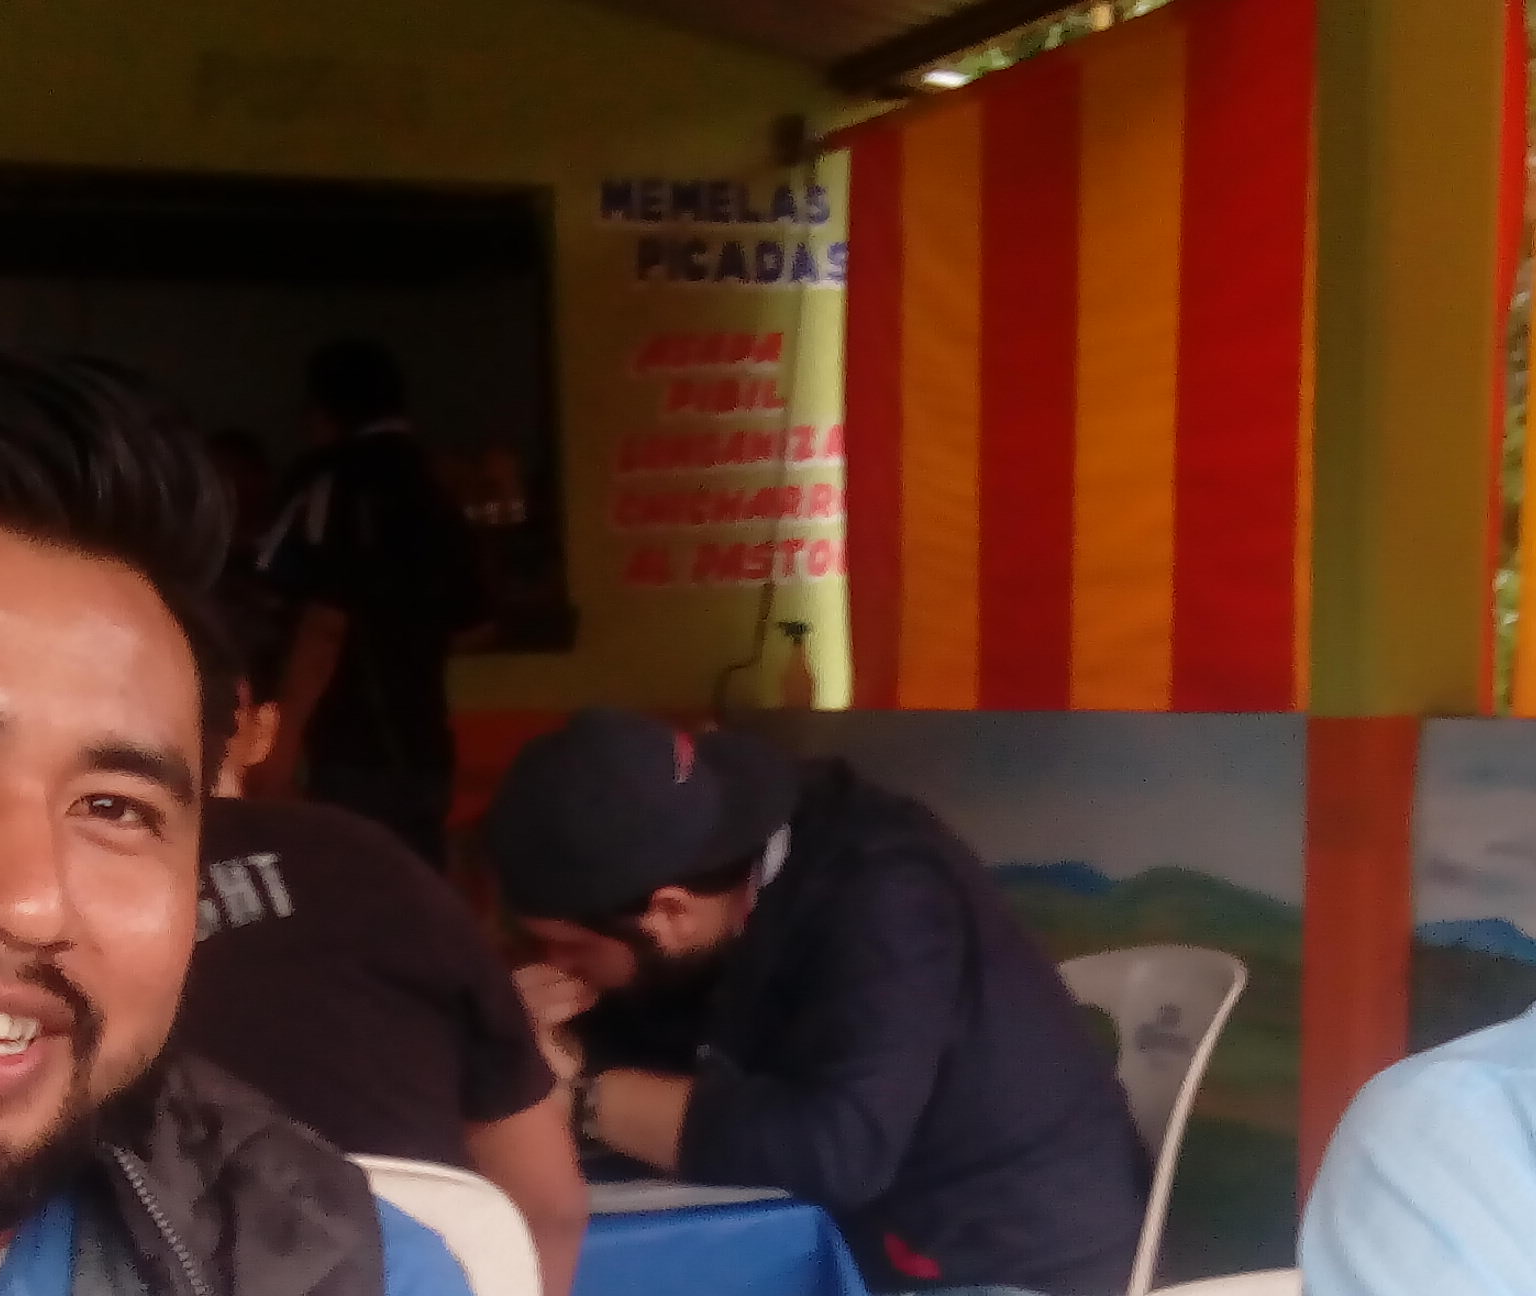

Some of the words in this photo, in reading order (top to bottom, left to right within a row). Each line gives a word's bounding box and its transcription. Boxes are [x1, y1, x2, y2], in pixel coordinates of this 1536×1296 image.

[600, 179, 831, 223] MEMELAS
[635, 238, 848, 282] PICADAS
[612, 484, 846, 527] CHICHARR
